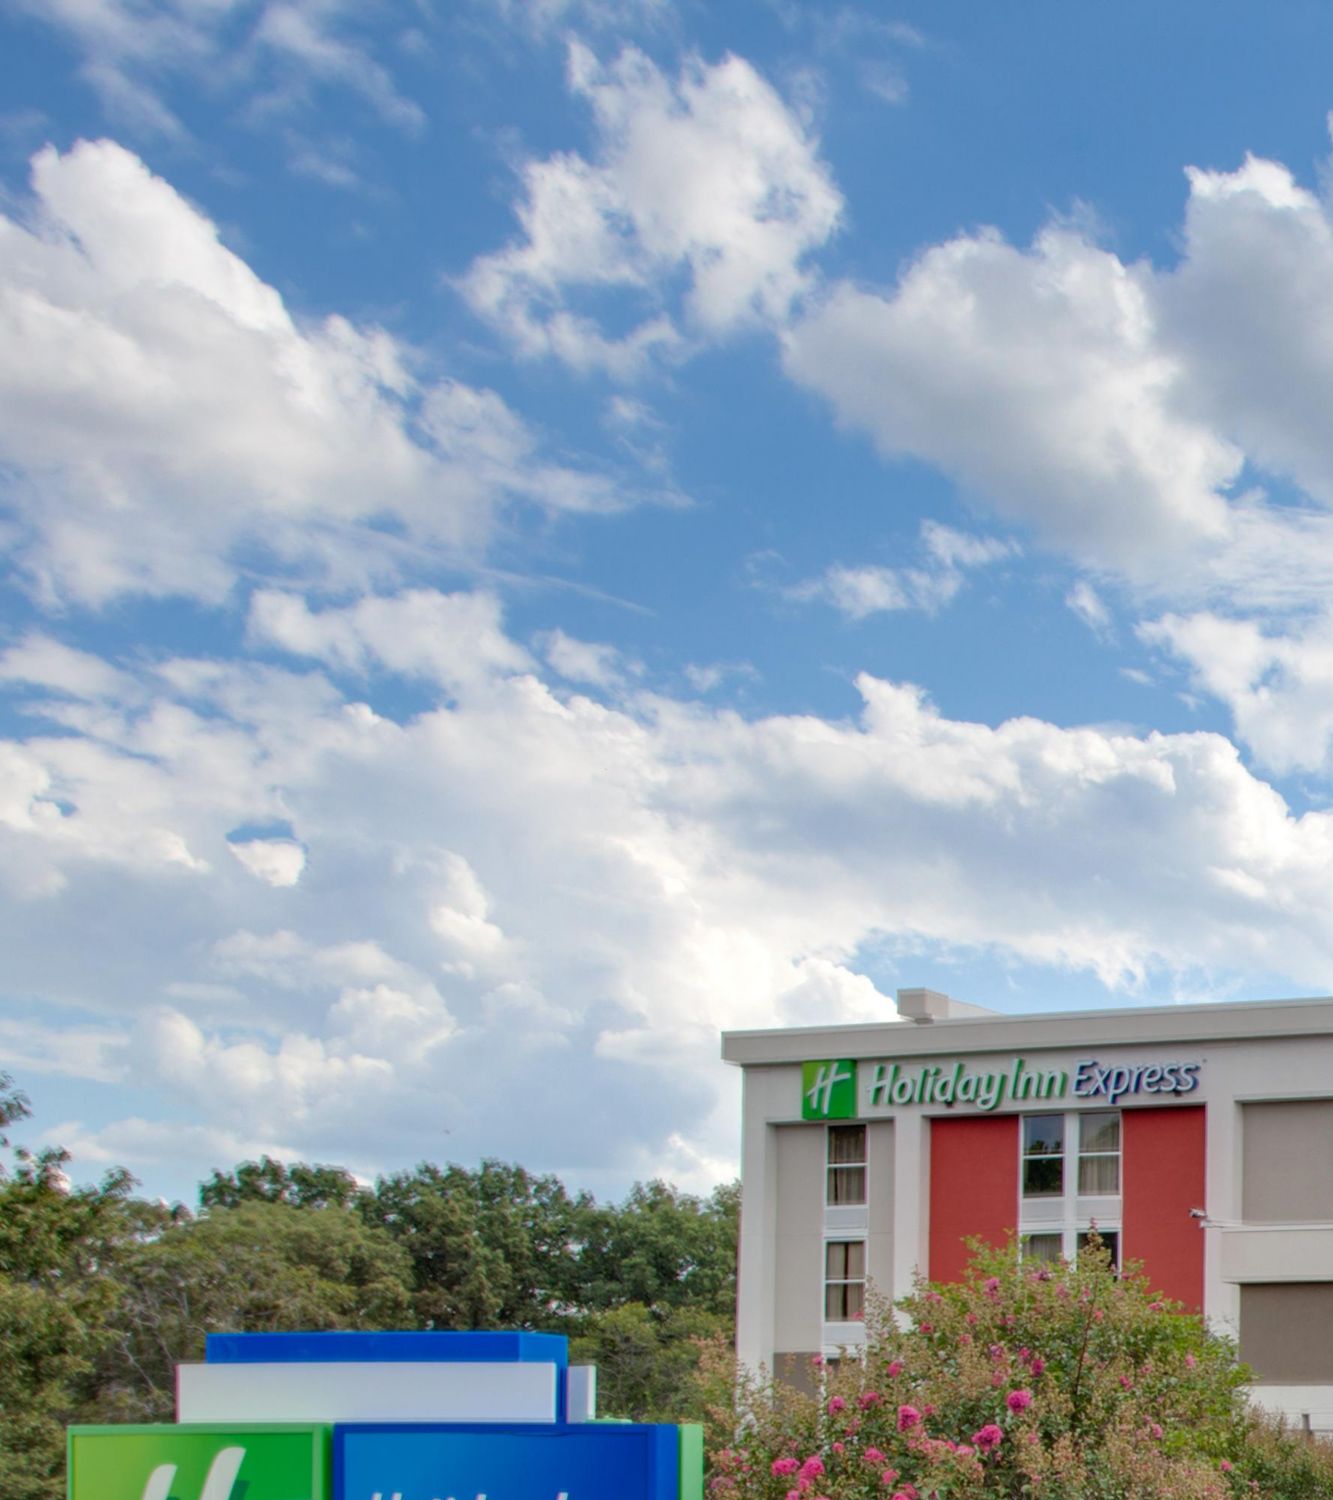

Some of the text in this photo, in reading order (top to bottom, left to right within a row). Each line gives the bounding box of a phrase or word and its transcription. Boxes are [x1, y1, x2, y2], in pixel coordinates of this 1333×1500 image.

[867, 1062, 1007, 1111] Holiday
[1007, 1056, 1068, 1099] Inn
[1071, 1059, 1200, 1105] Express
